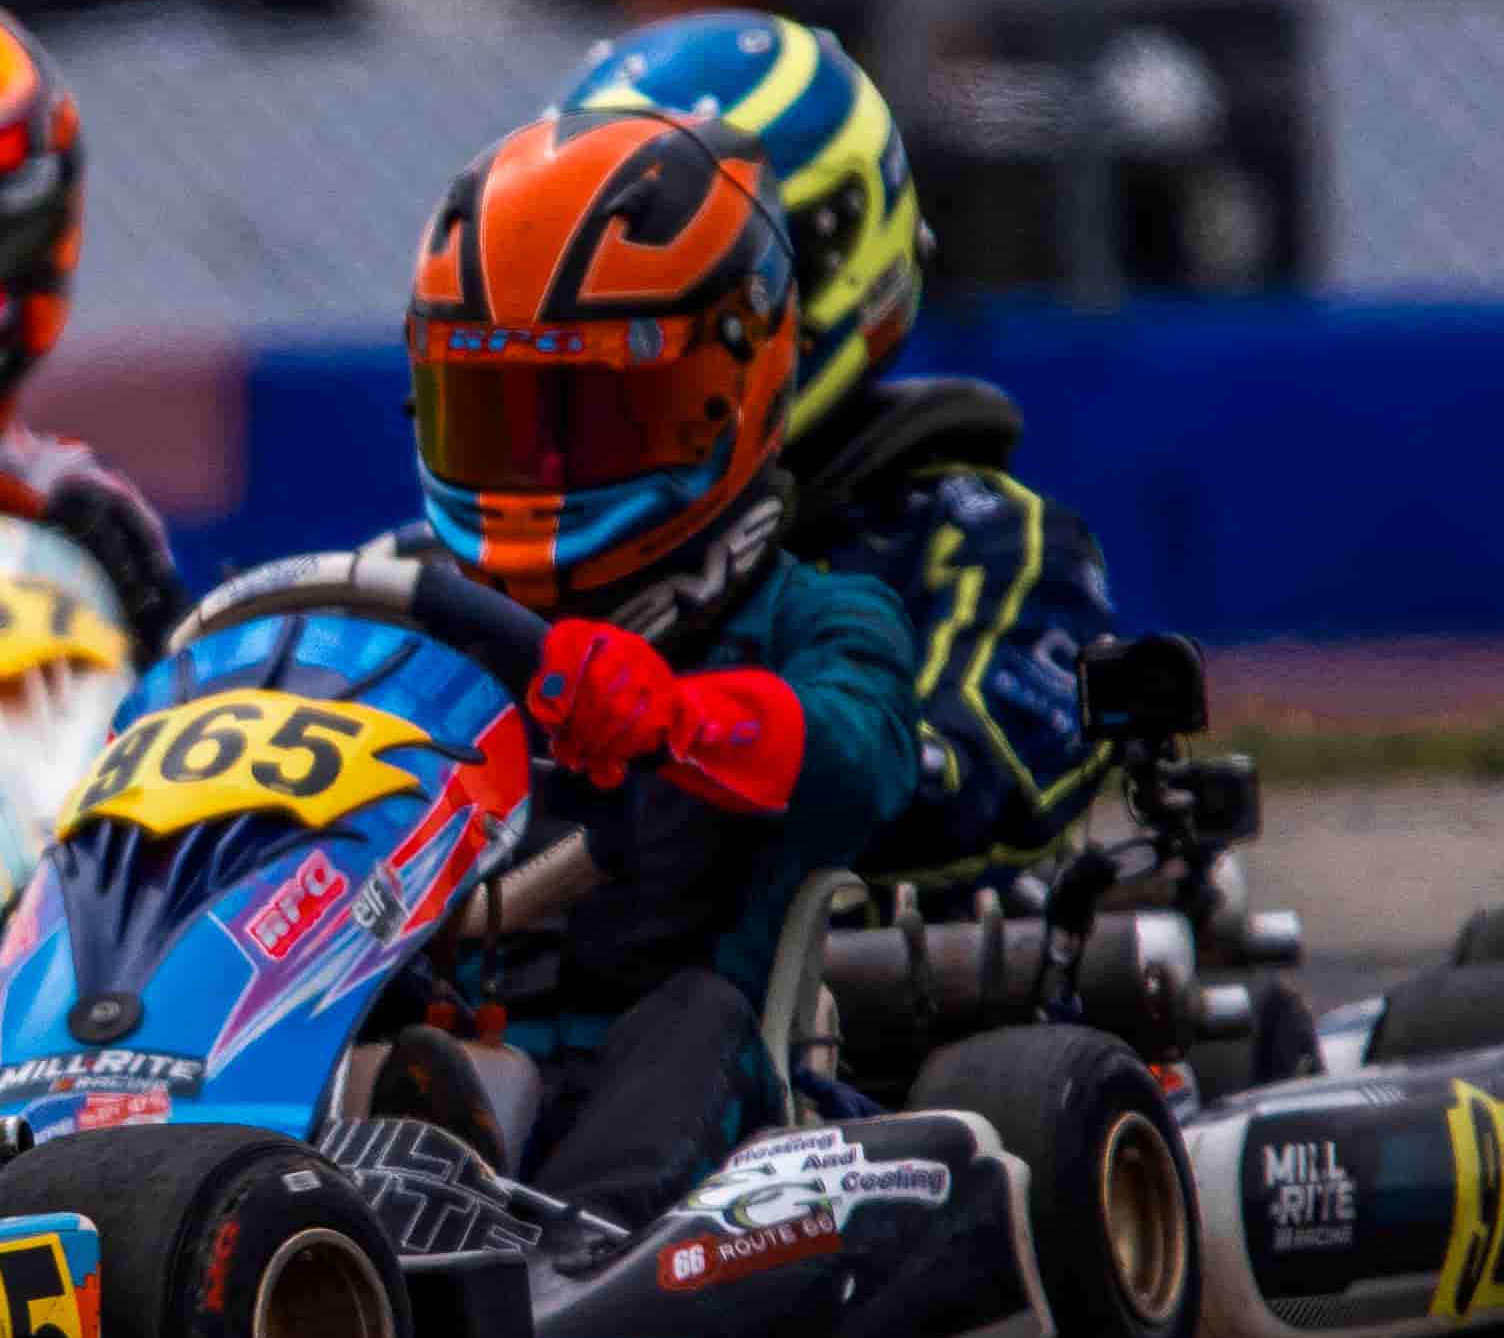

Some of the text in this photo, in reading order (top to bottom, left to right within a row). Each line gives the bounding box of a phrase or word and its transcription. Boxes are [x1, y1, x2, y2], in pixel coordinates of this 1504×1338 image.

[80, 703, 362, 809] 965
[352, 878, 386, 928] elf
[842, 1164, 945, 1195] Cooling
[1263, 1141, 1346, 1189] MILL
[672, 1244, 705, 1281] 66
[717, 1223, 798, 1262] ROUTE
